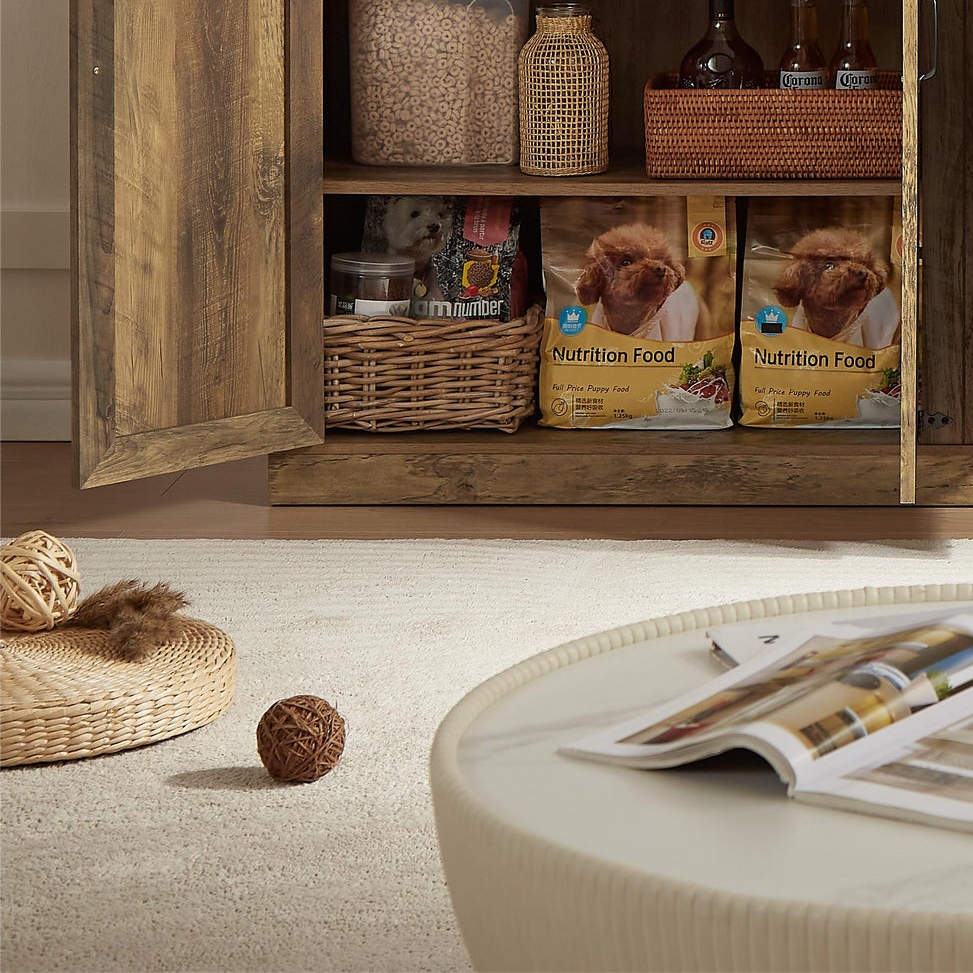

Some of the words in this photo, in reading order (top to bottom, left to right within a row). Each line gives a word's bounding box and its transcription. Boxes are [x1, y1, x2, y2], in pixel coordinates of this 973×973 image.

[782, 73, 823, 87] Corona
[452, 299, 504, 316] number
[553, 346, 628, 363] Nutrition
[633, 347, 675, 363] Food
[754, 348, 829, 367] Nutrition
[834, 351, 876, 369] Food
[567, 384, 584, 392] Price
[587, 384, 610, 394] Puppy
[613, 385, 630, 393] Food
[768, 388, 786, 396] Price
[788, 389, 811, 397] Puppy
